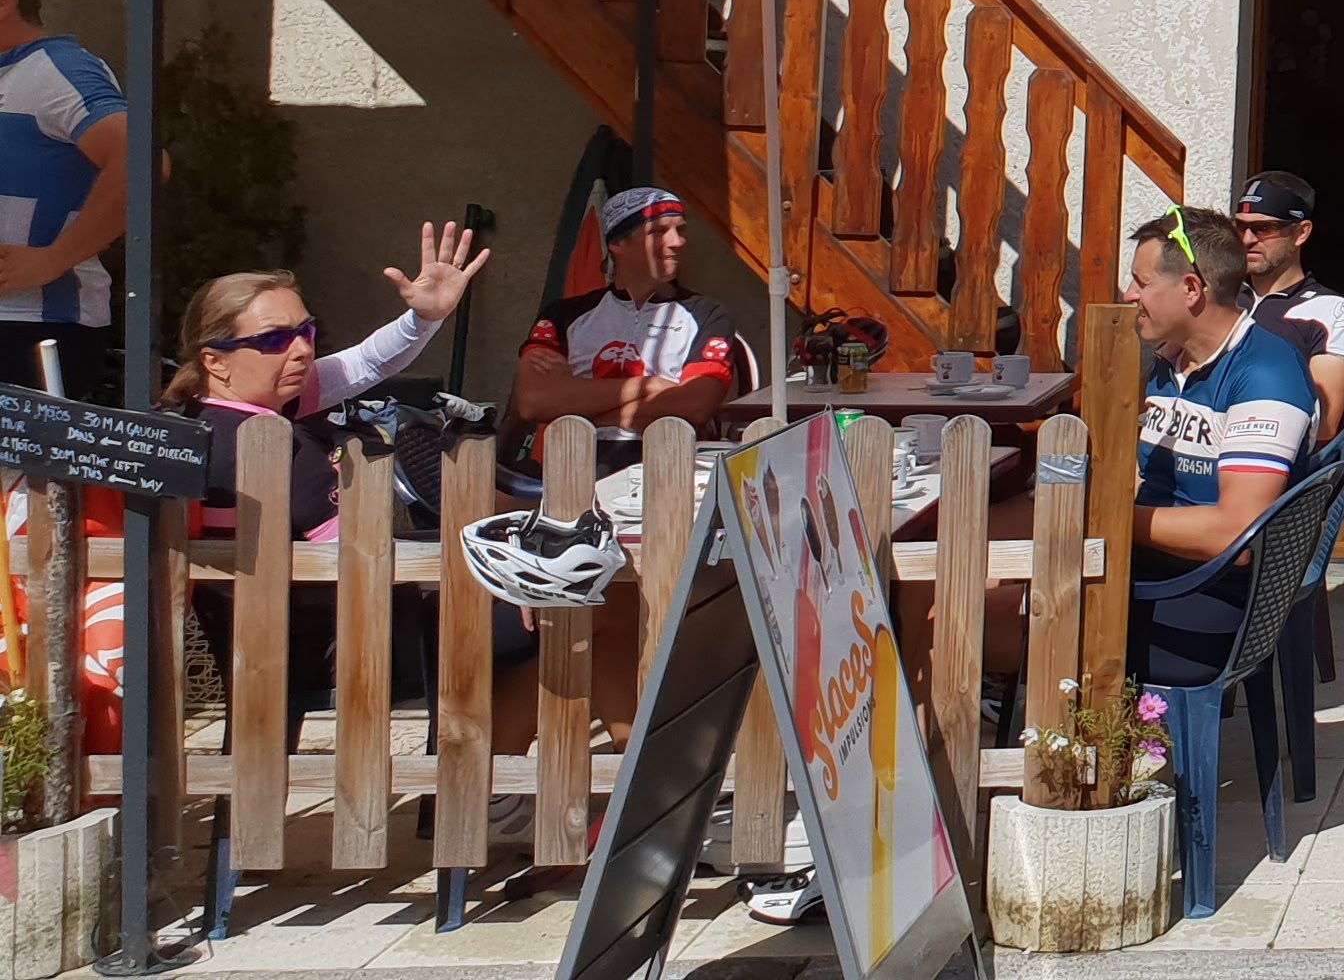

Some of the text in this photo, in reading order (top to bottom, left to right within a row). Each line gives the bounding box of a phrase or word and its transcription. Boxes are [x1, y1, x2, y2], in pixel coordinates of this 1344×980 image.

[67, 427, 95, 444] DANS
[127, 440, 154, 454] CETTE
[126, 422, 169, 441] GAUCHE
[114, 460, 145, 474] LEFT
[1177, 457, 1213, 476] 2645M
[80, 466, 103, 481] THIS
[140, 477, 163, 492] WAY
